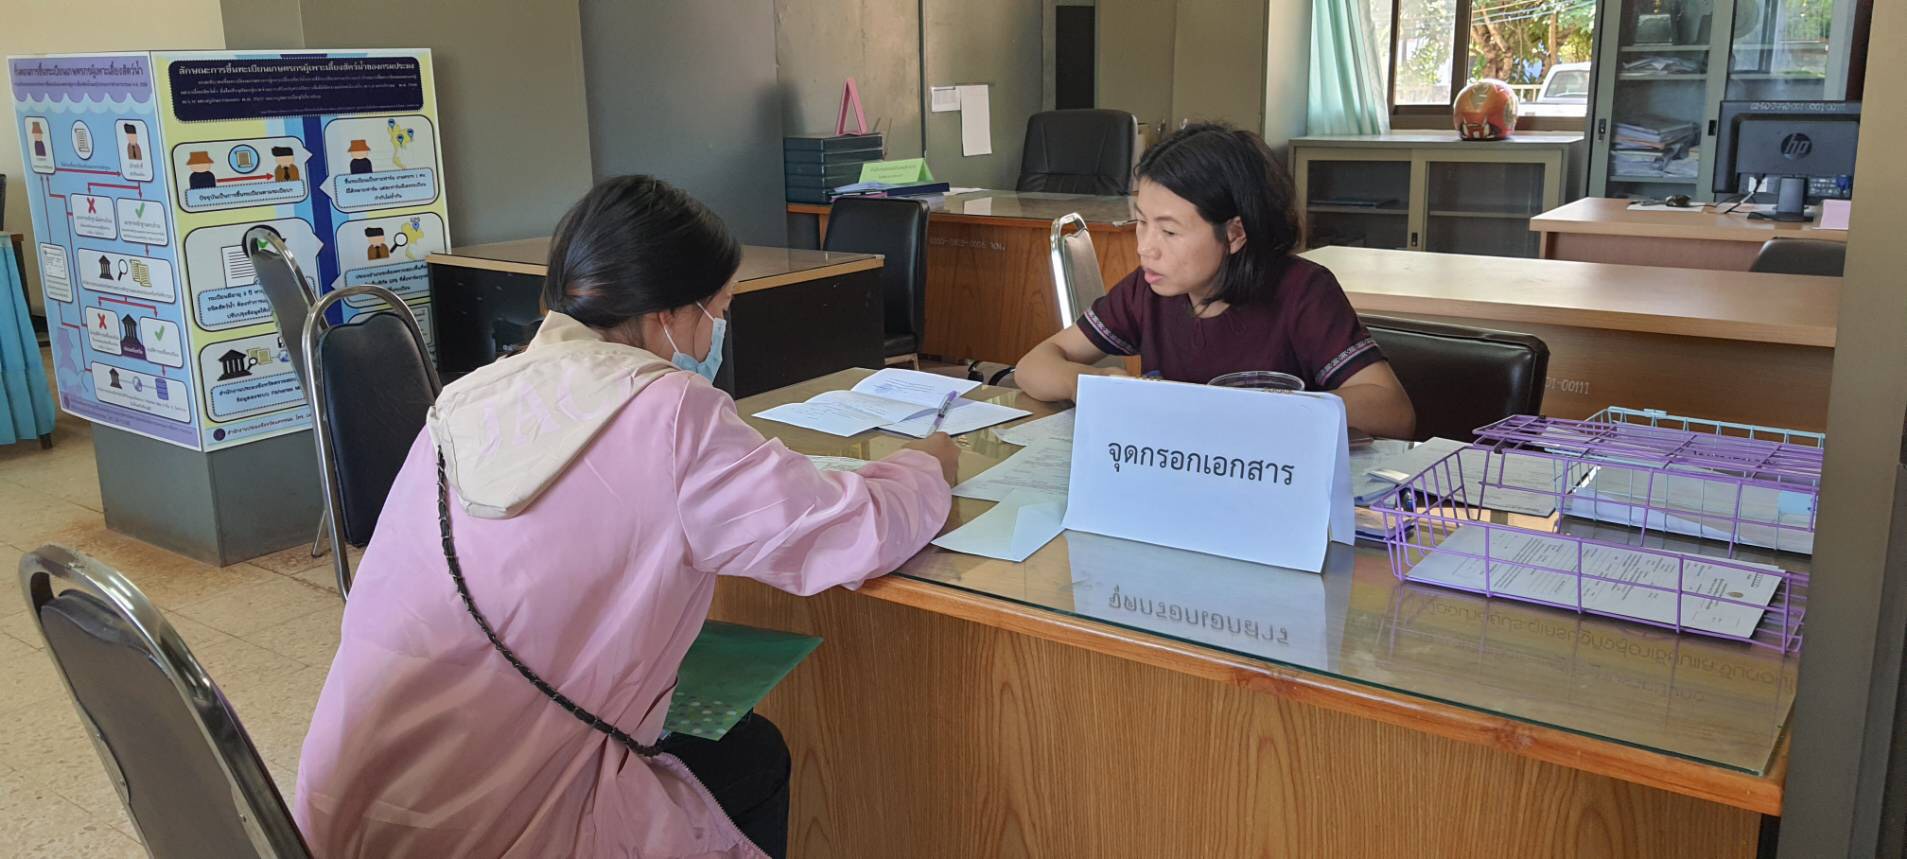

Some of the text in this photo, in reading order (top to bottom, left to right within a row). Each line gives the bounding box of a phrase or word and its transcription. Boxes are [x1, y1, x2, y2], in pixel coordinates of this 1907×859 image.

[1785, 133, 1809, 157] hp
[1108, 442, 1295, 486] จุดกรอกเอกสาร
